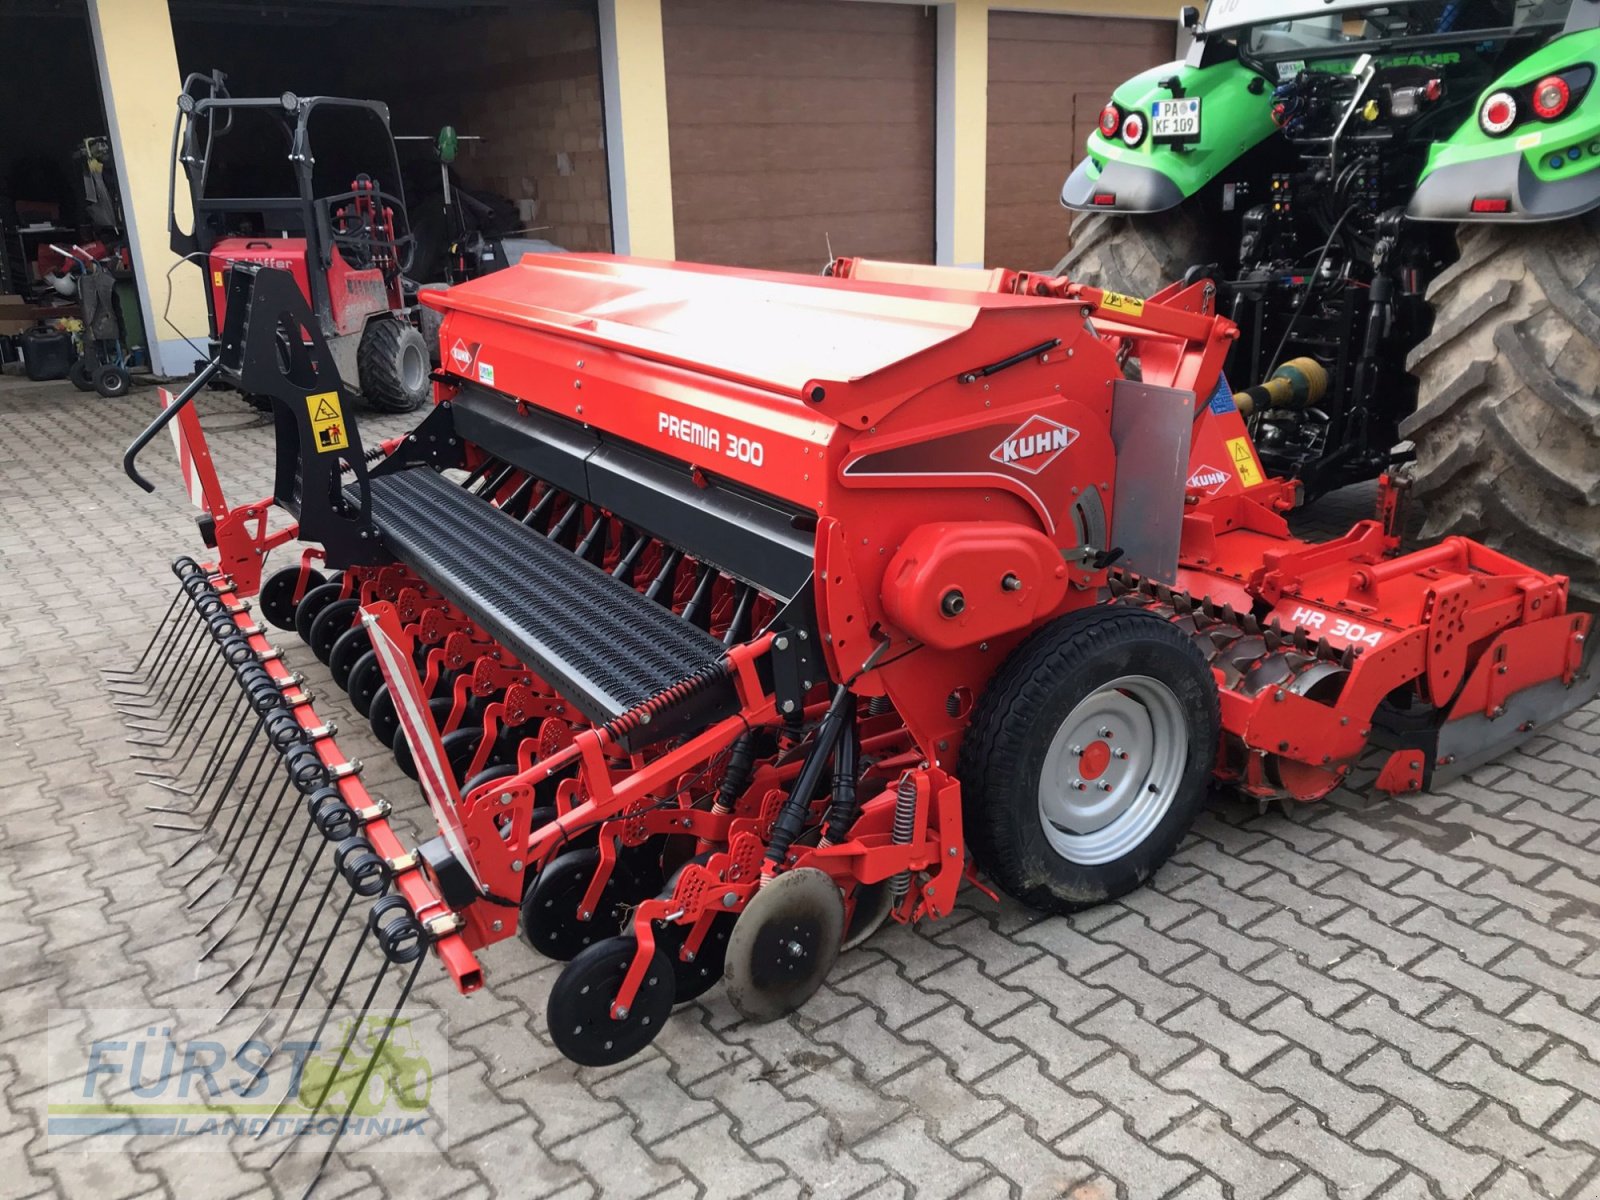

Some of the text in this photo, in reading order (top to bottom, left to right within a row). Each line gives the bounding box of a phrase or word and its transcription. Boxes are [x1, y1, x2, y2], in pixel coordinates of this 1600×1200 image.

[1164, 102, 1179, 117] PA
[1156, 117, 1194, 133] KF 109
[658, 411, 764, 468] PREMIA 300
[1003, 427, 1068, 462] KUHN
[1191, 472, 1226, 487] KUHN
[1291, 606, 1383, 647] HR 304
